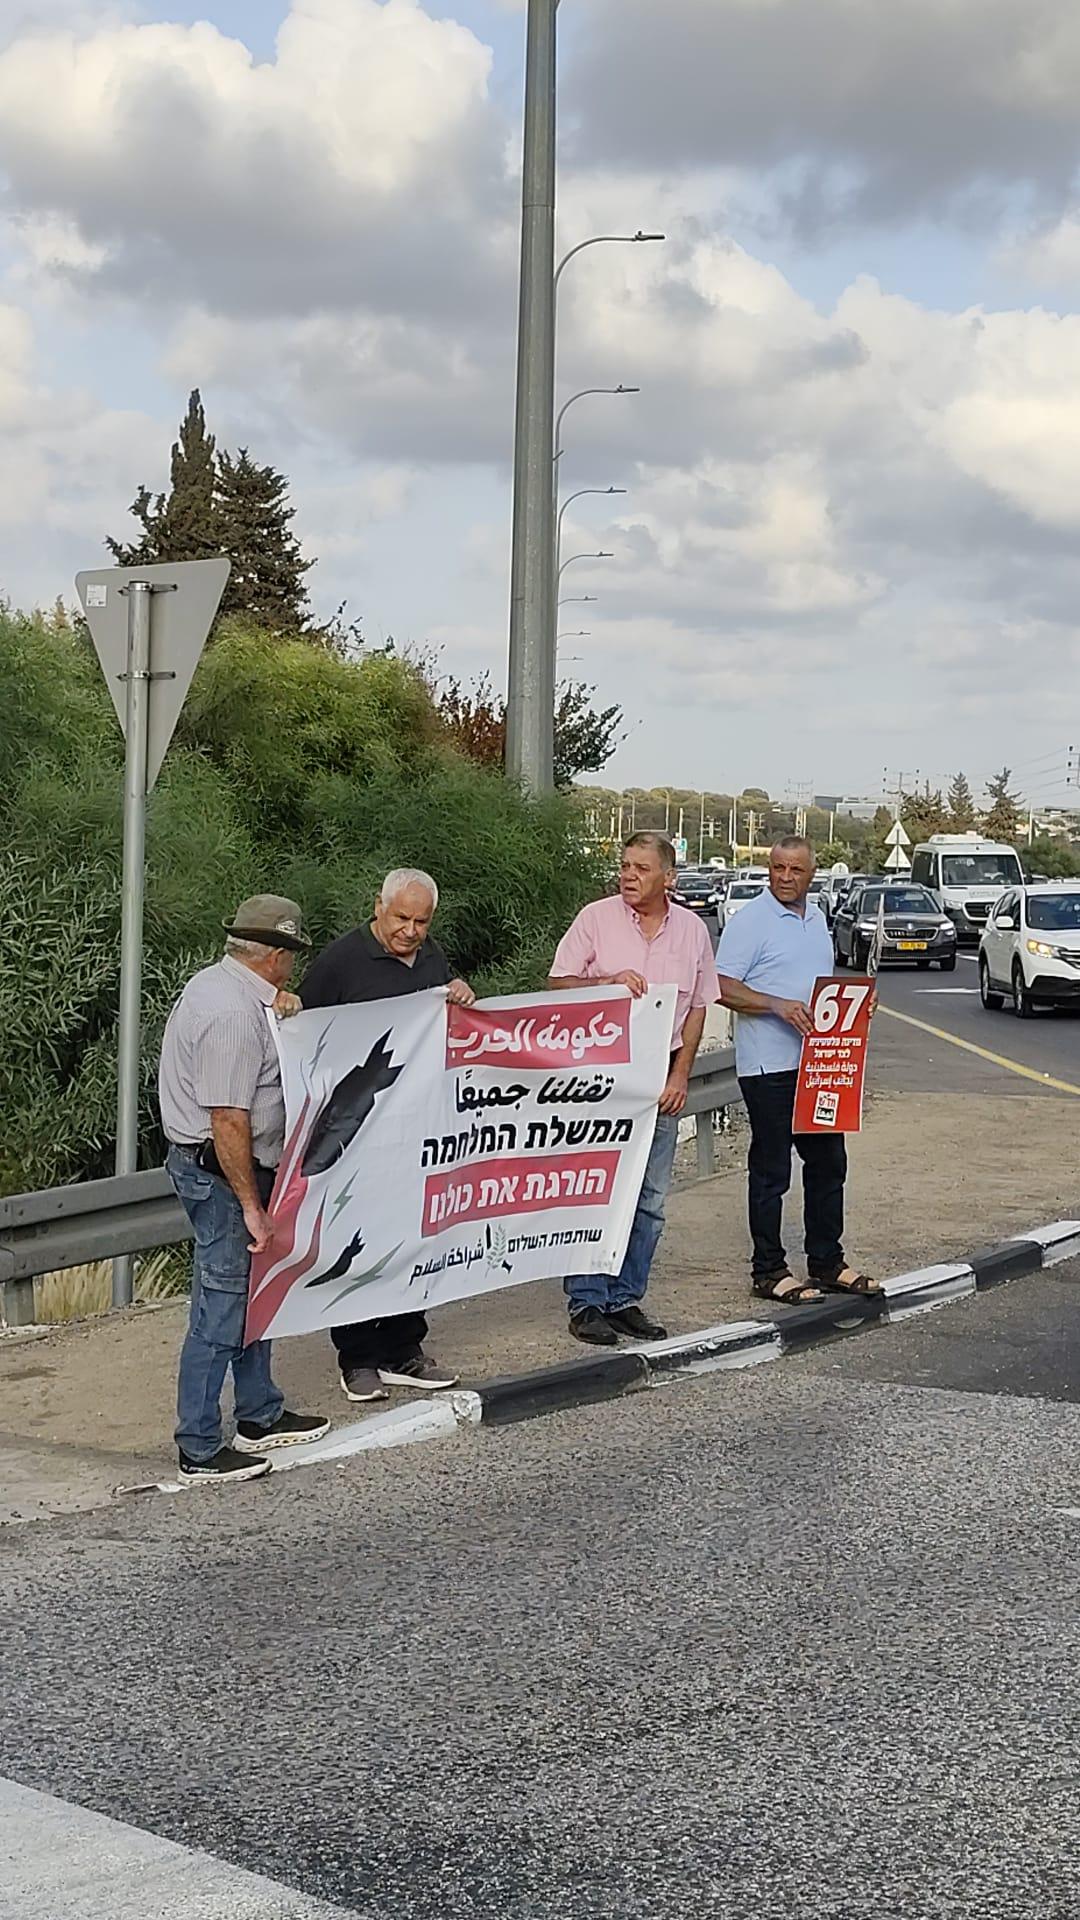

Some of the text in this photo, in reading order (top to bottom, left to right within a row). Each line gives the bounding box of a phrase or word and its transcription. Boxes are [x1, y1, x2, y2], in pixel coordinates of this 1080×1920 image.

[813, 983, 870, 1033] 67
[447, 1011, 623, 1060] حكومة الحرب
[537, 1073, 615, 1105] تقتلنا
[421, 1115, 634, 1167] ממשלת המלחמה
[429, 1168, 608, 1225] הורגת את כולנו
[409, 1238, 484, 1286] شراكة السلام
[508, 1229, 603, 1253] שותפות השלום
